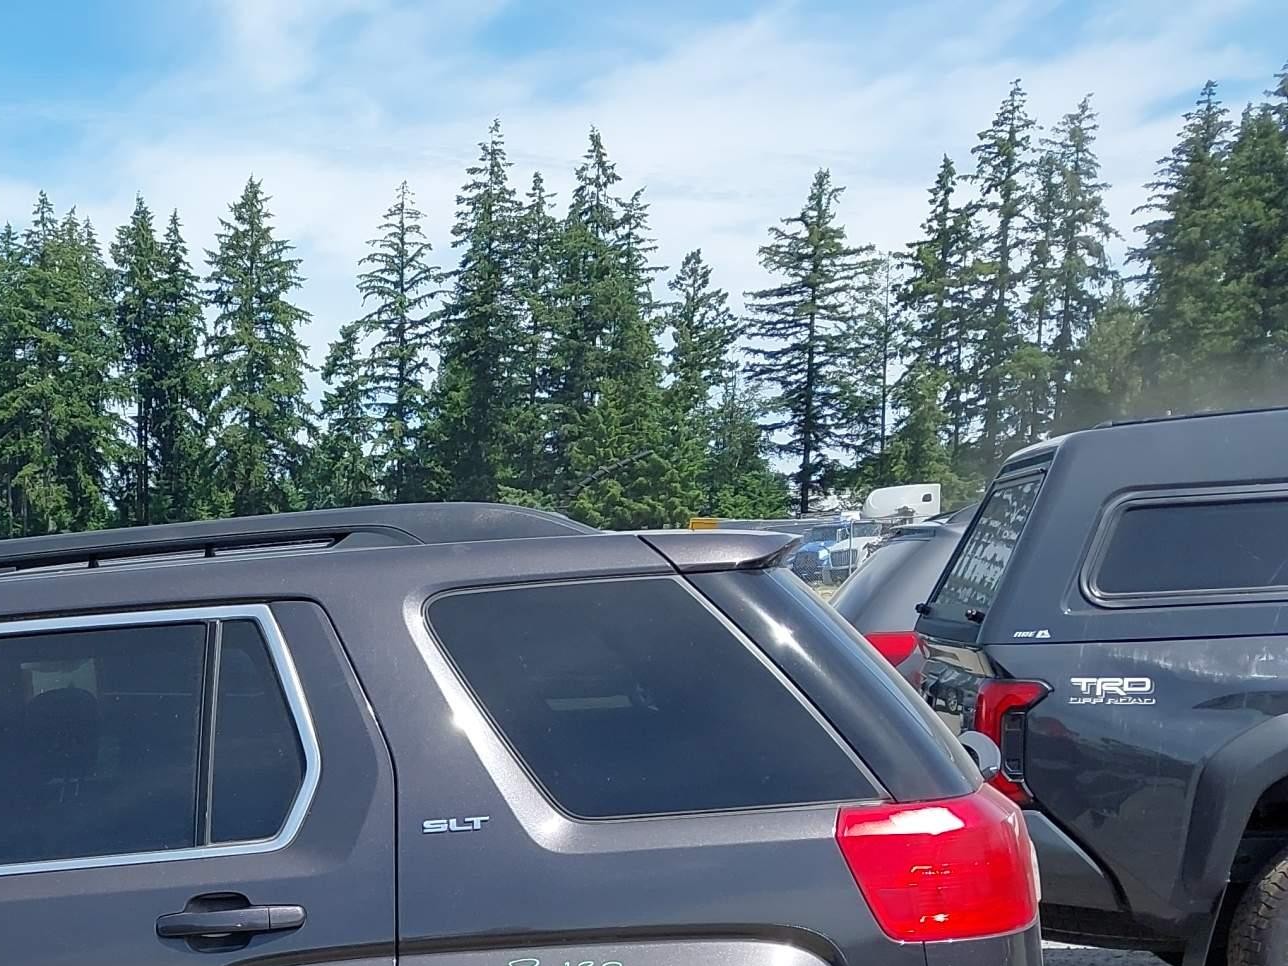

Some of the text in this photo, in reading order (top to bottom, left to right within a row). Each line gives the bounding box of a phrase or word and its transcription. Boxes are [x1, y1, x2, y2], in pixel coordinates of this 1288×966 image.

[1070, 677, 1155, 698] TRD
[1068, 697, 1157, 705] OFF ROAD
[422, 816, 490, 834] SLT
